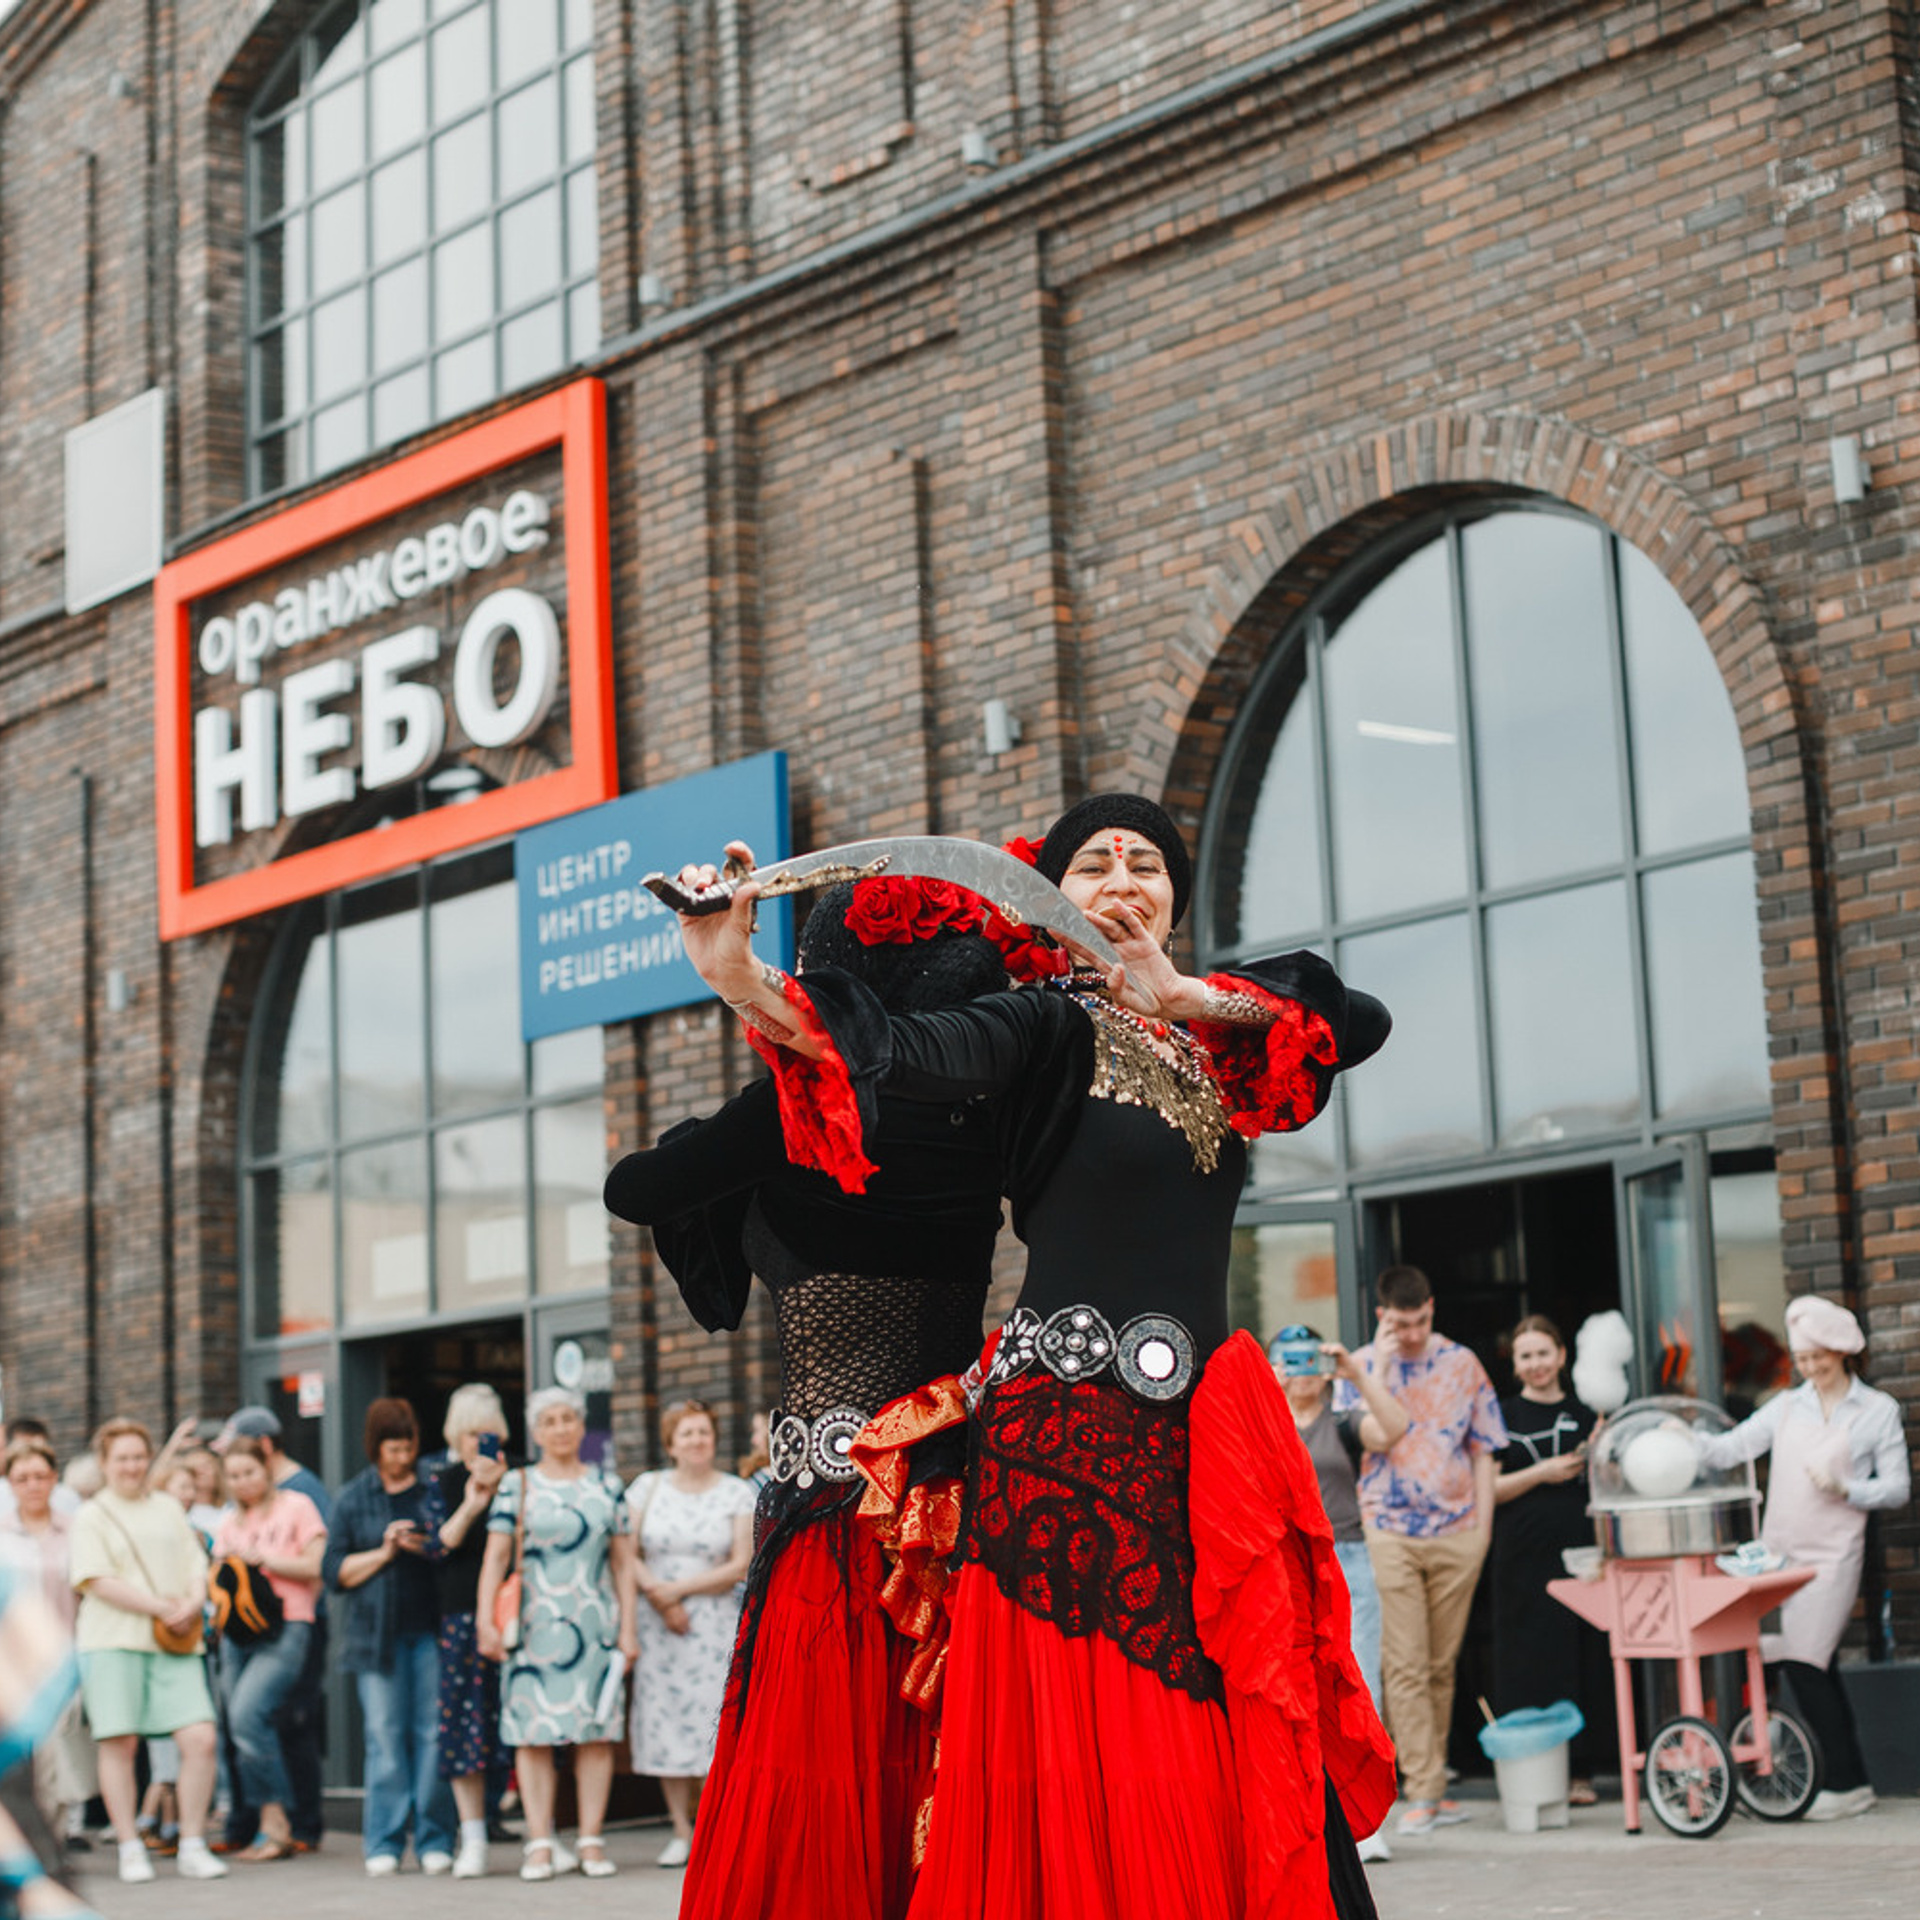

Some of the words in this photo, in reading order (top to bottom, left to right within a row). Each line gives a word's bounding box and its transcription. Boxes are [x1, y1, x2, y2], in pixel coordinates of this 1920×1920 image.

[199, 490, 549, 683] оранжевое
[195, 588, 561, 847] НЕБО
[537, 840, 631, 898] ЦЕНТР
[540, 922, 682, 993] РЕШЕНИЙ
